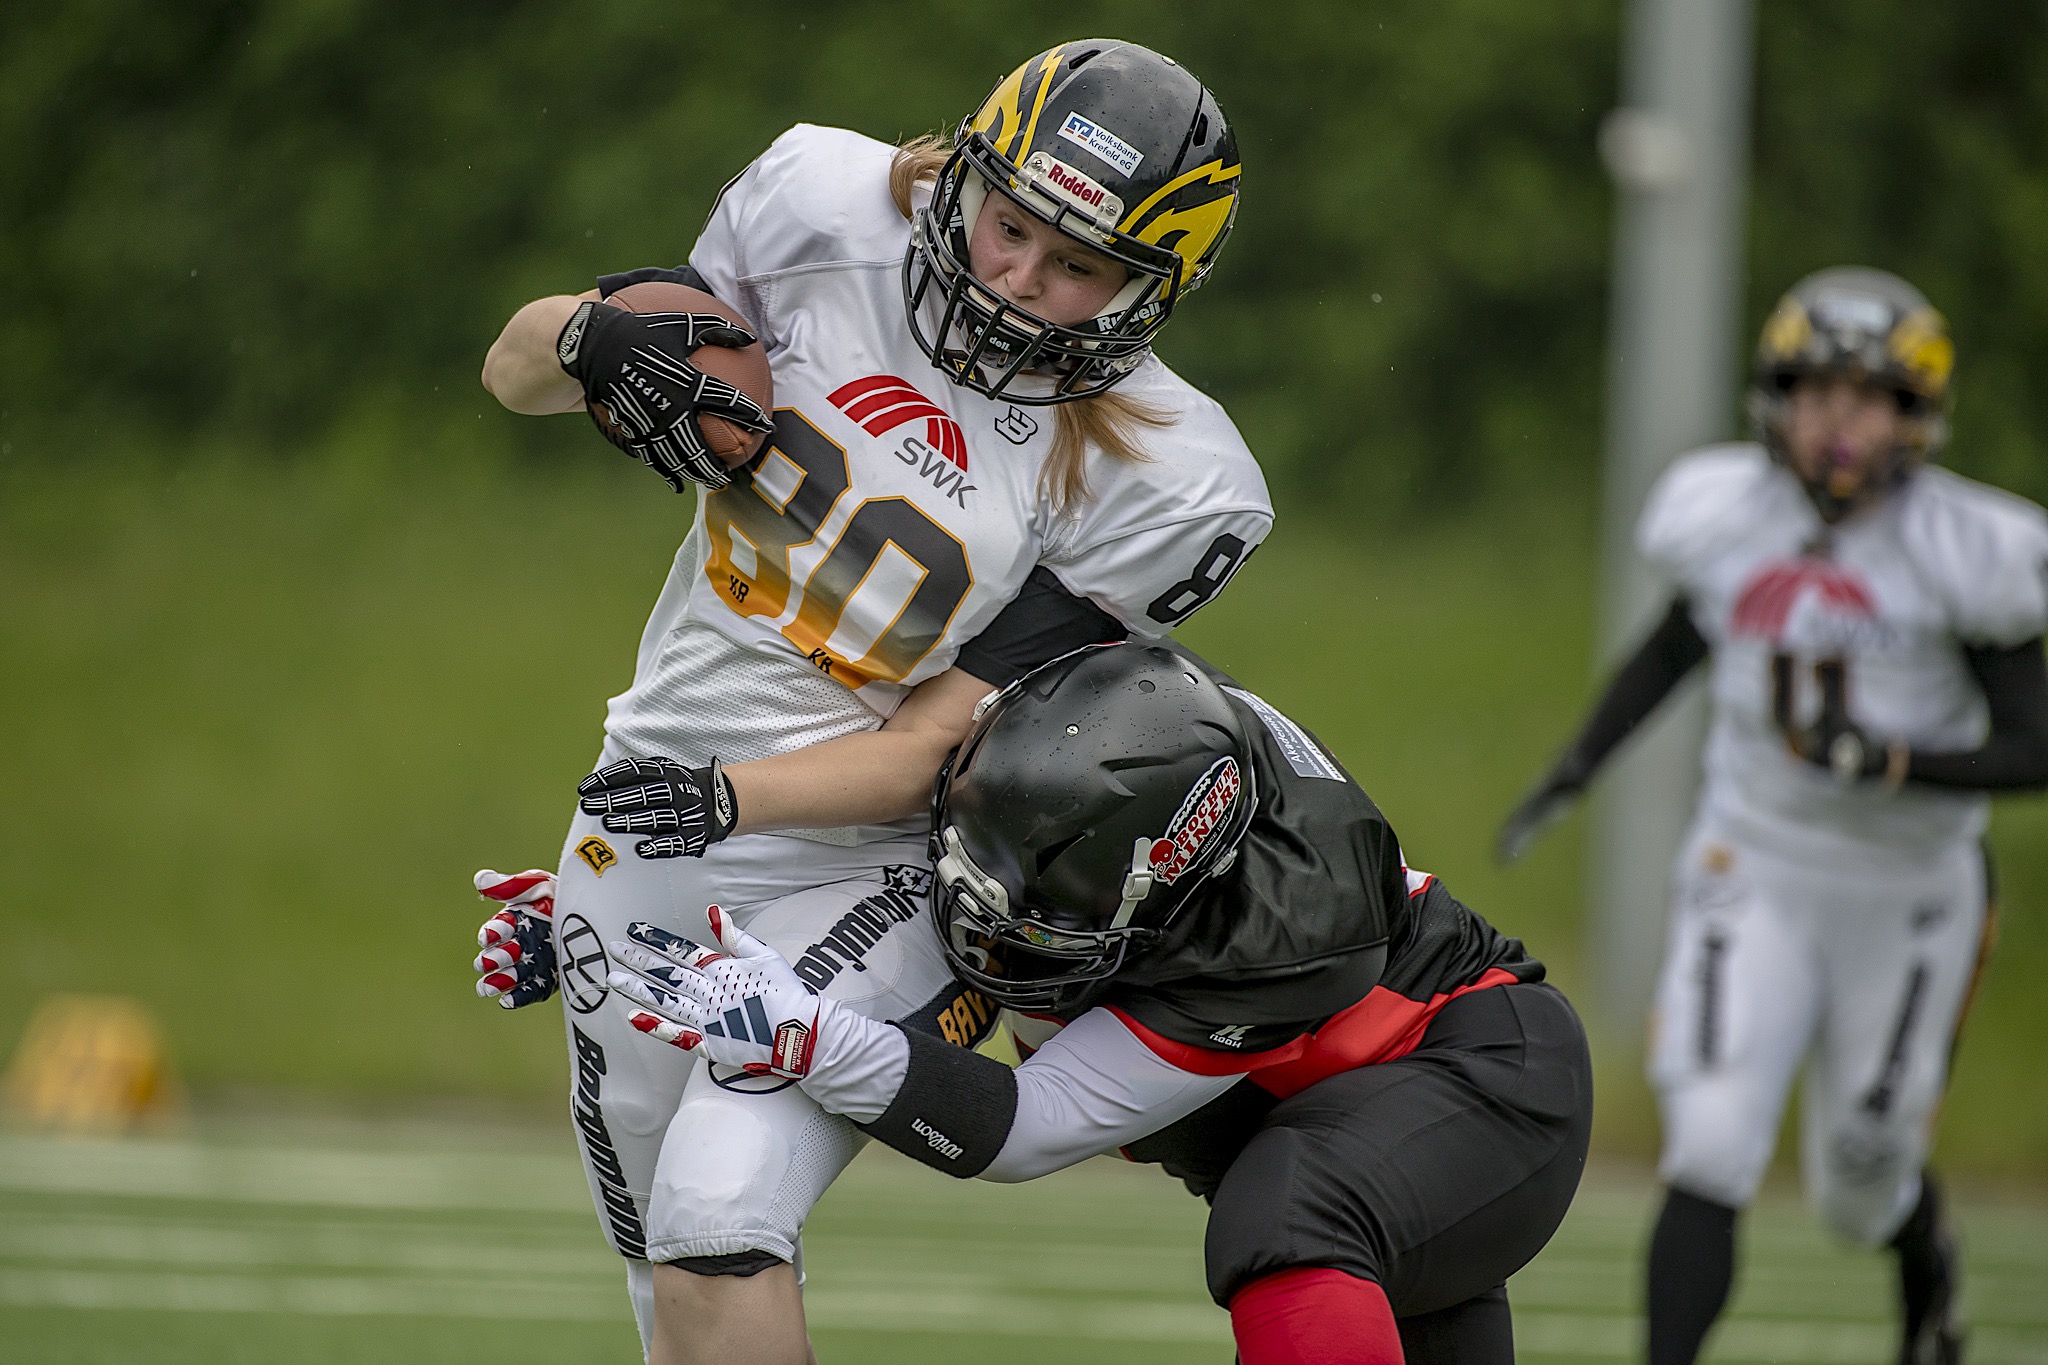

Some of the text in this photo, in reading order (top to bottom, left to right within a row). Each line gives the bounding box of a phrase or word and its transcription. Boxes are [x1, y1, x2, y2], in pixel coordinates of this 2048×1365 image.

[1089, 138, 1132, 170] Krefeld eG
[1095, 129, 1138, 161] Volksbank
[1048, 164, 1105, 207] Riddell
[620, 363, 671, 411] KIPSTA
[894, 437, 978, 510] SWK
[704, 406, 975, 690] 80
[1174, 761, 1234, 847] BOCHUM
[1161, 770, 1241, 887] MINERS
[911, 1118, 964, 1160] Wilson
